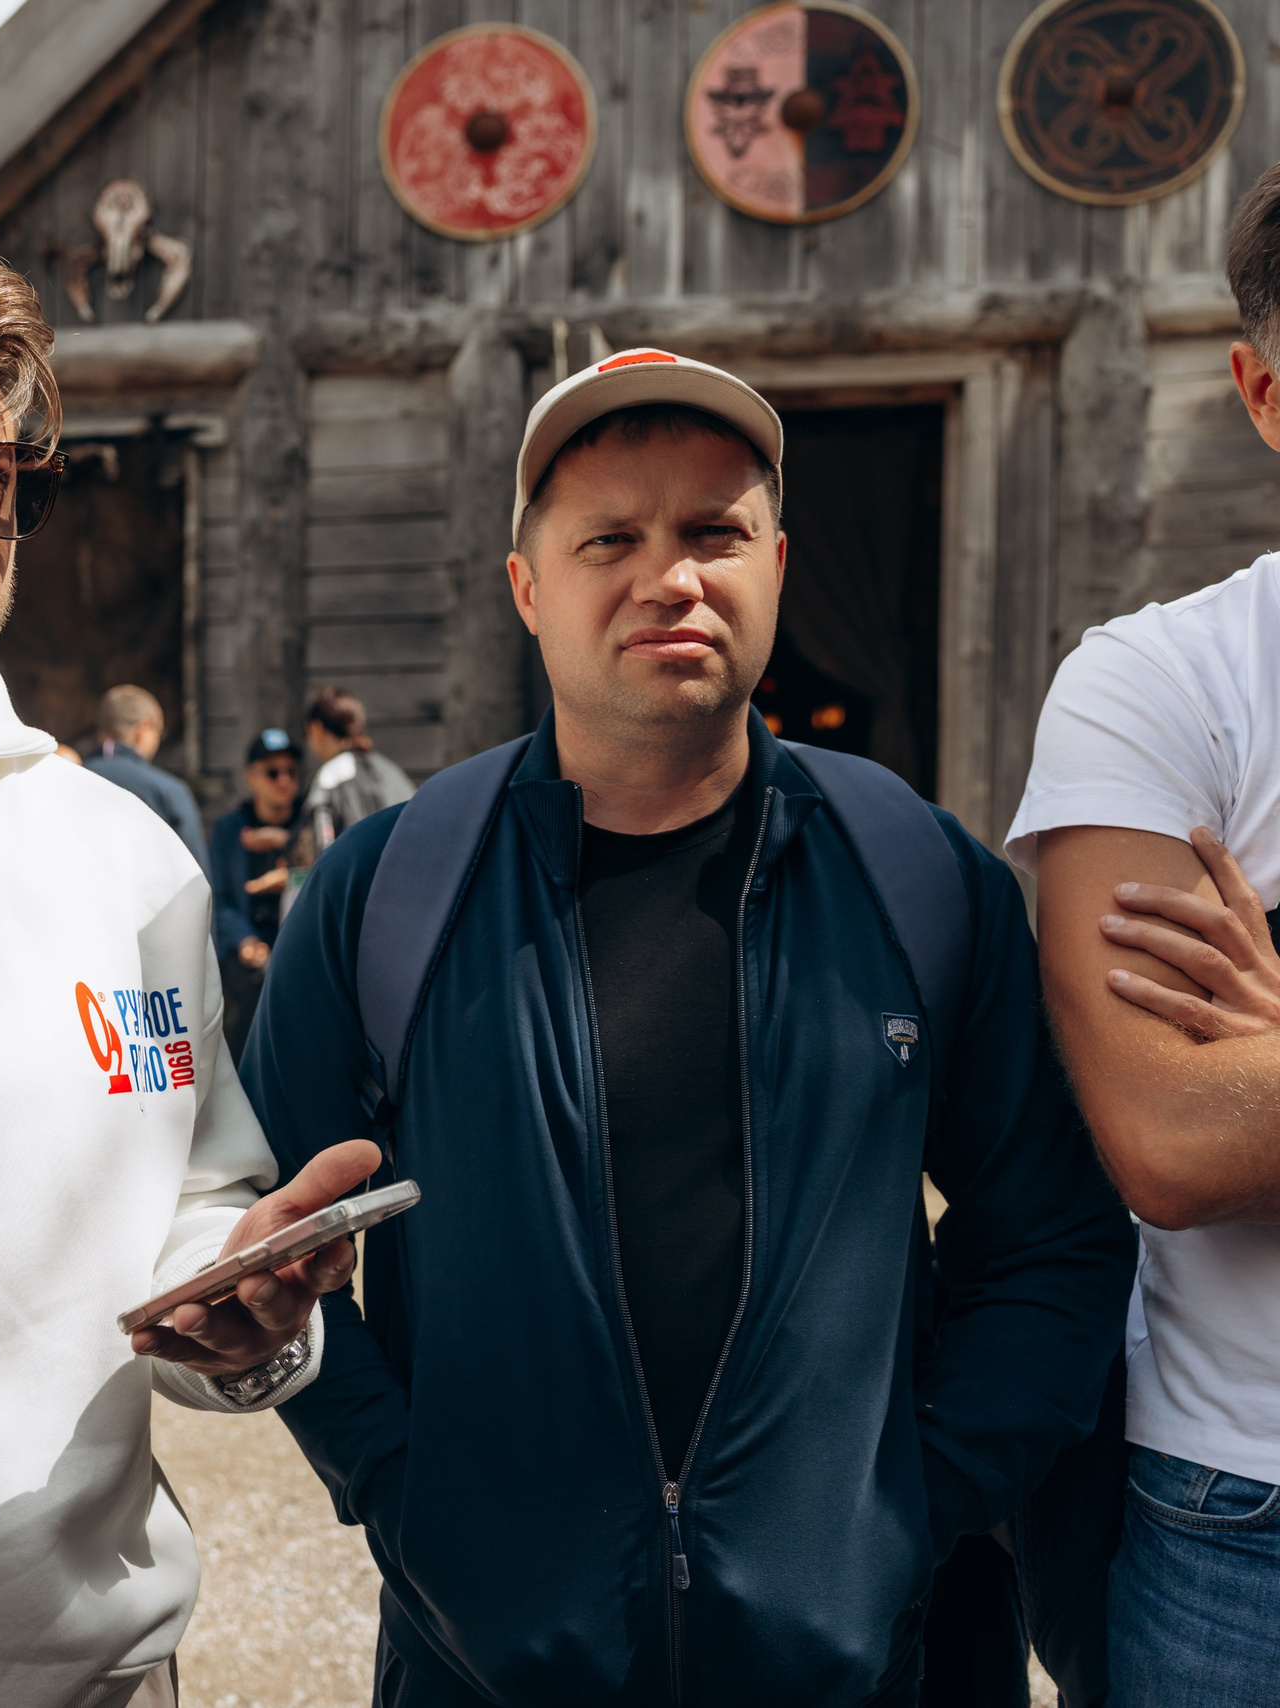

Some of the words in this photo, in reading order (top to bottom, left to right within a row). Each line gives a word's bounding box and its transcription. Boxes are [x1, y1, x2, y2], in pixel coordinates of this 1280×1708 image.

[113, 987, 188, 1038] РУКОЕ
[129, 1044, 167, 1092] РИО
[164, 1040, 195, 1090] 106.6
